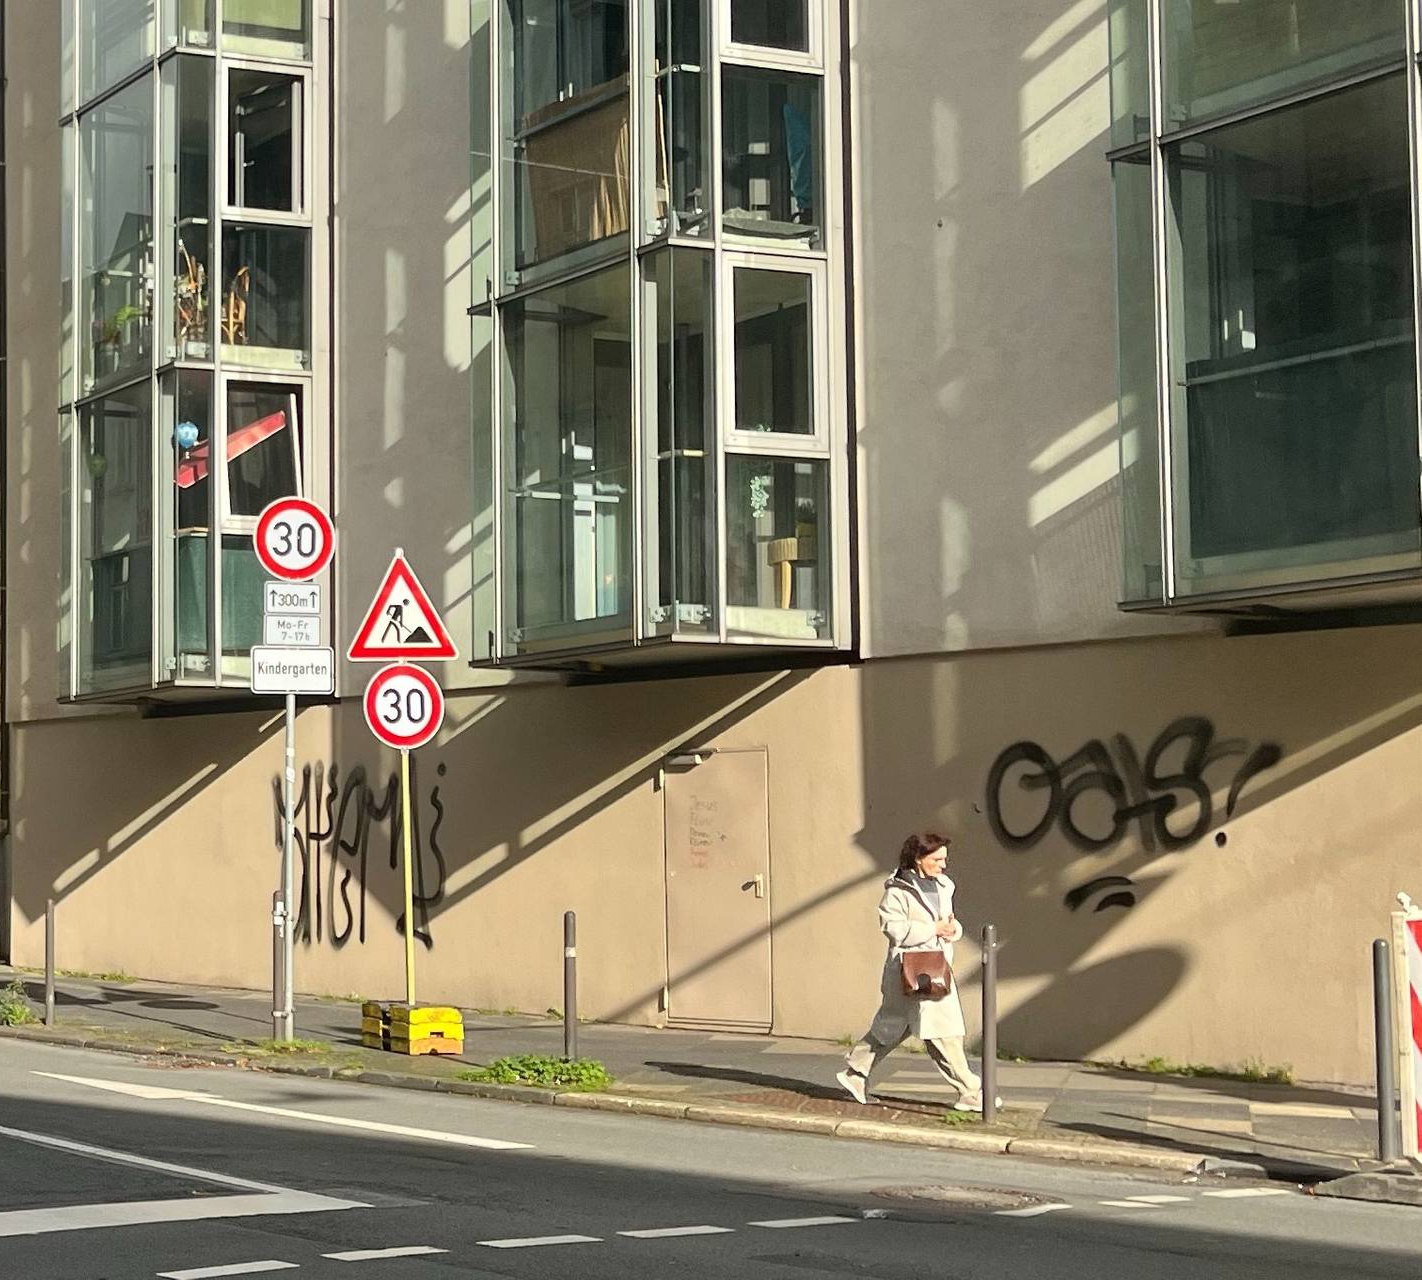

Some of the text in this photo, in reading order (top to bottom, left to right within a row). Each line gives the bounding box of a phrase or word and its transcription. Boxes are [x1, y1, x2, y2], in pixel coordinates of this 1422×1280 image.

[272, 521, 316, 558] 30
[278, 593, 308, 607] 300m
[258, 661, 327, 678] Kindergarten
[382, 688, 425, 724] 30
